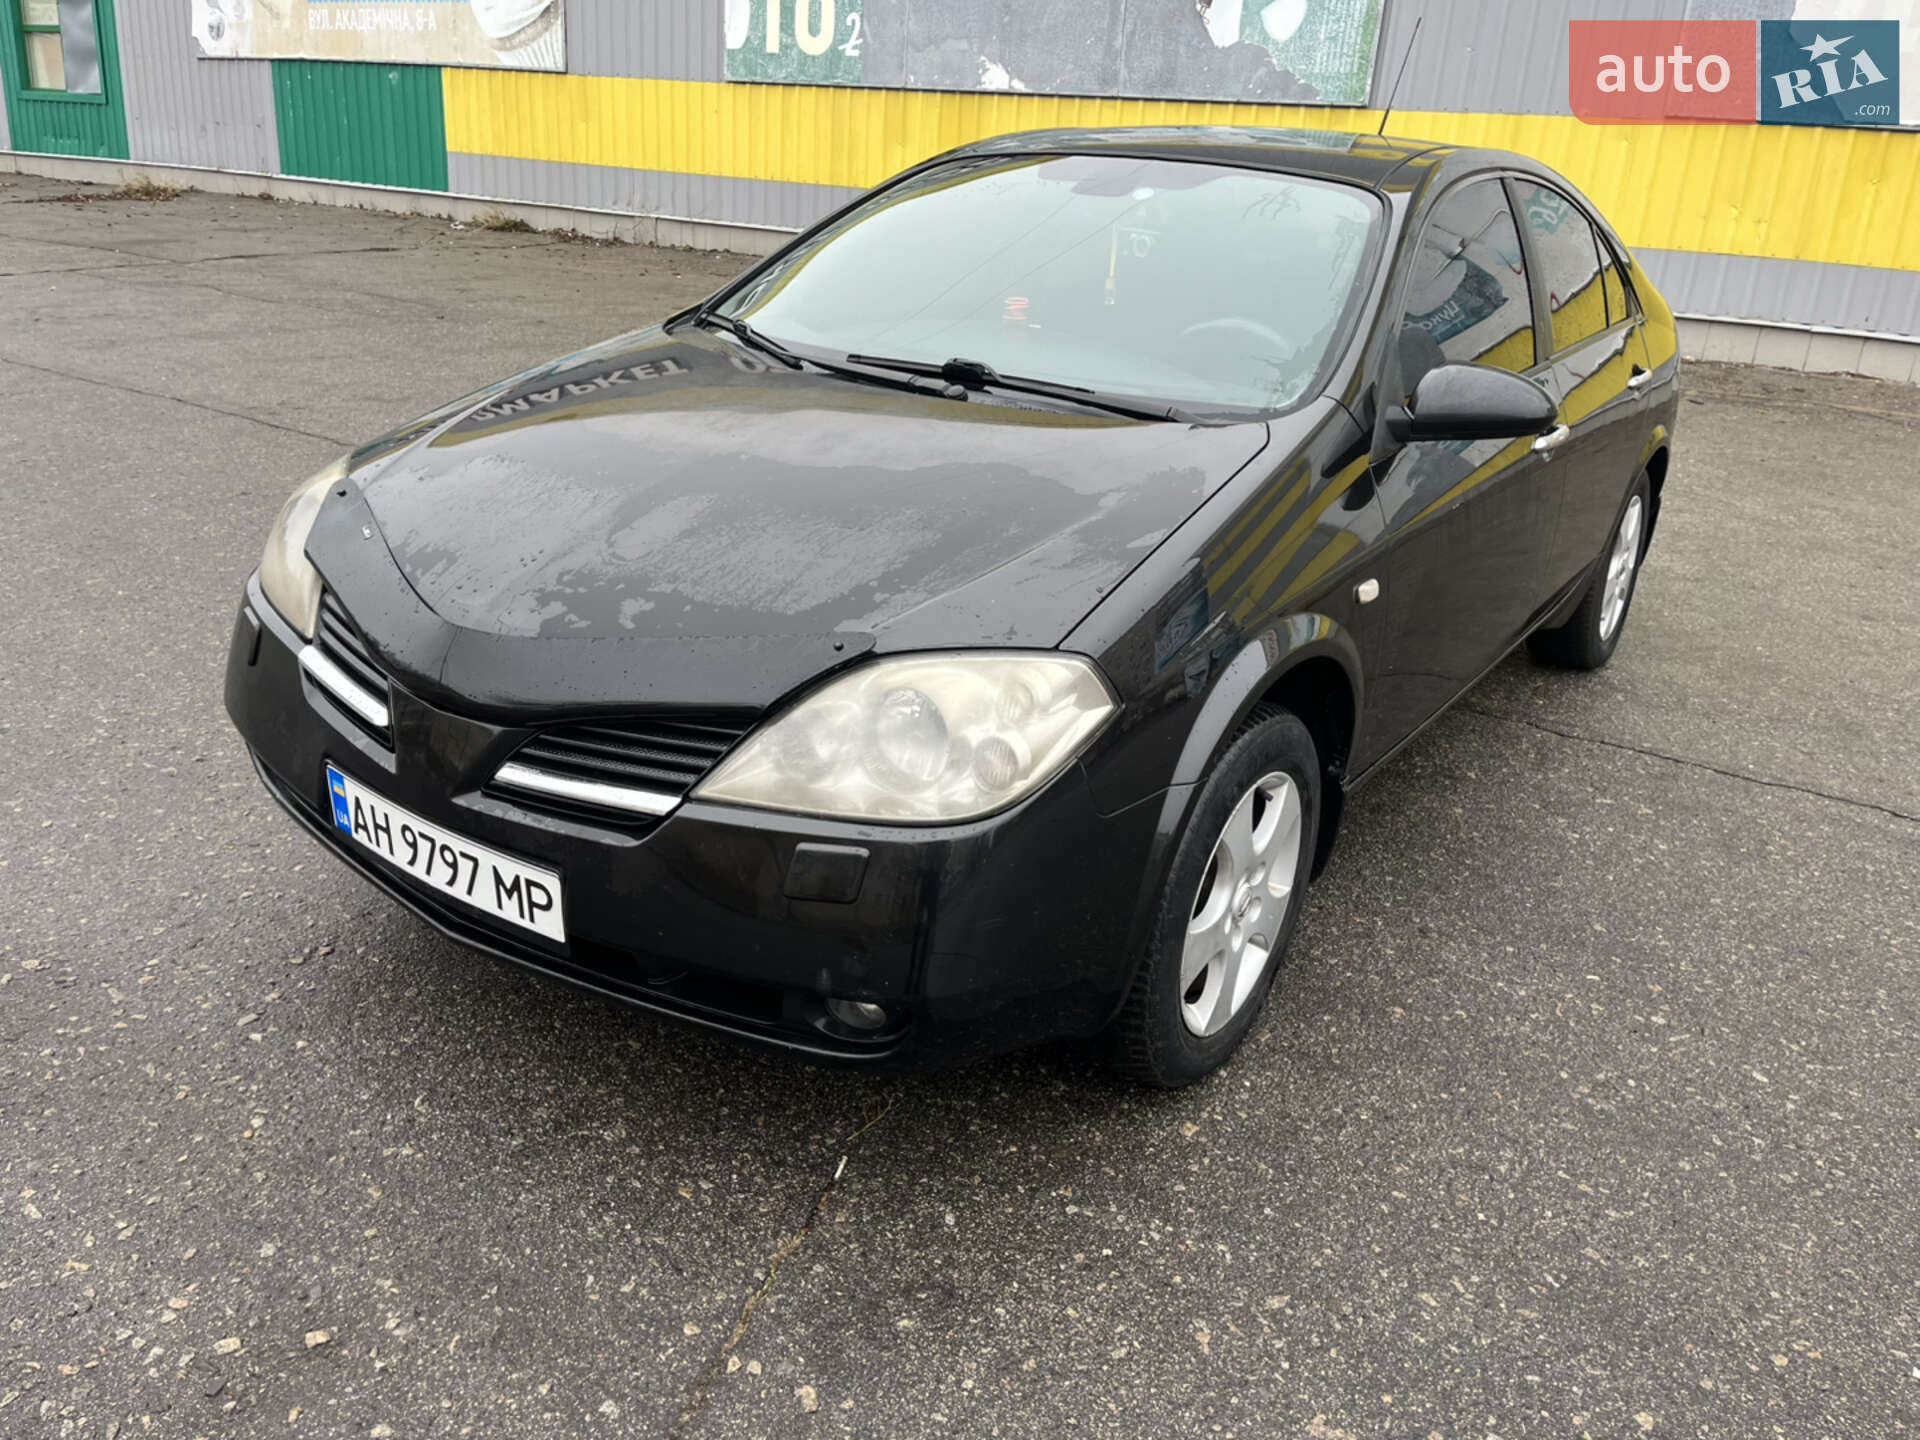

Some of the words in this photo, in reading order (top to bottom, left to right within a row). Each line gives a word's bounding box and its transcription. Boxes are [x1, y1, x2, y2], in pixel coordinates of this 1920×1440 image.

[308, 8, 333, 31] ВУЛ.
[337, 809, 350, 828] UA
[354, 795, 395, 857] AH
[401, 823, 479, 897] 9797
[492, 864, 553, 924] MP
